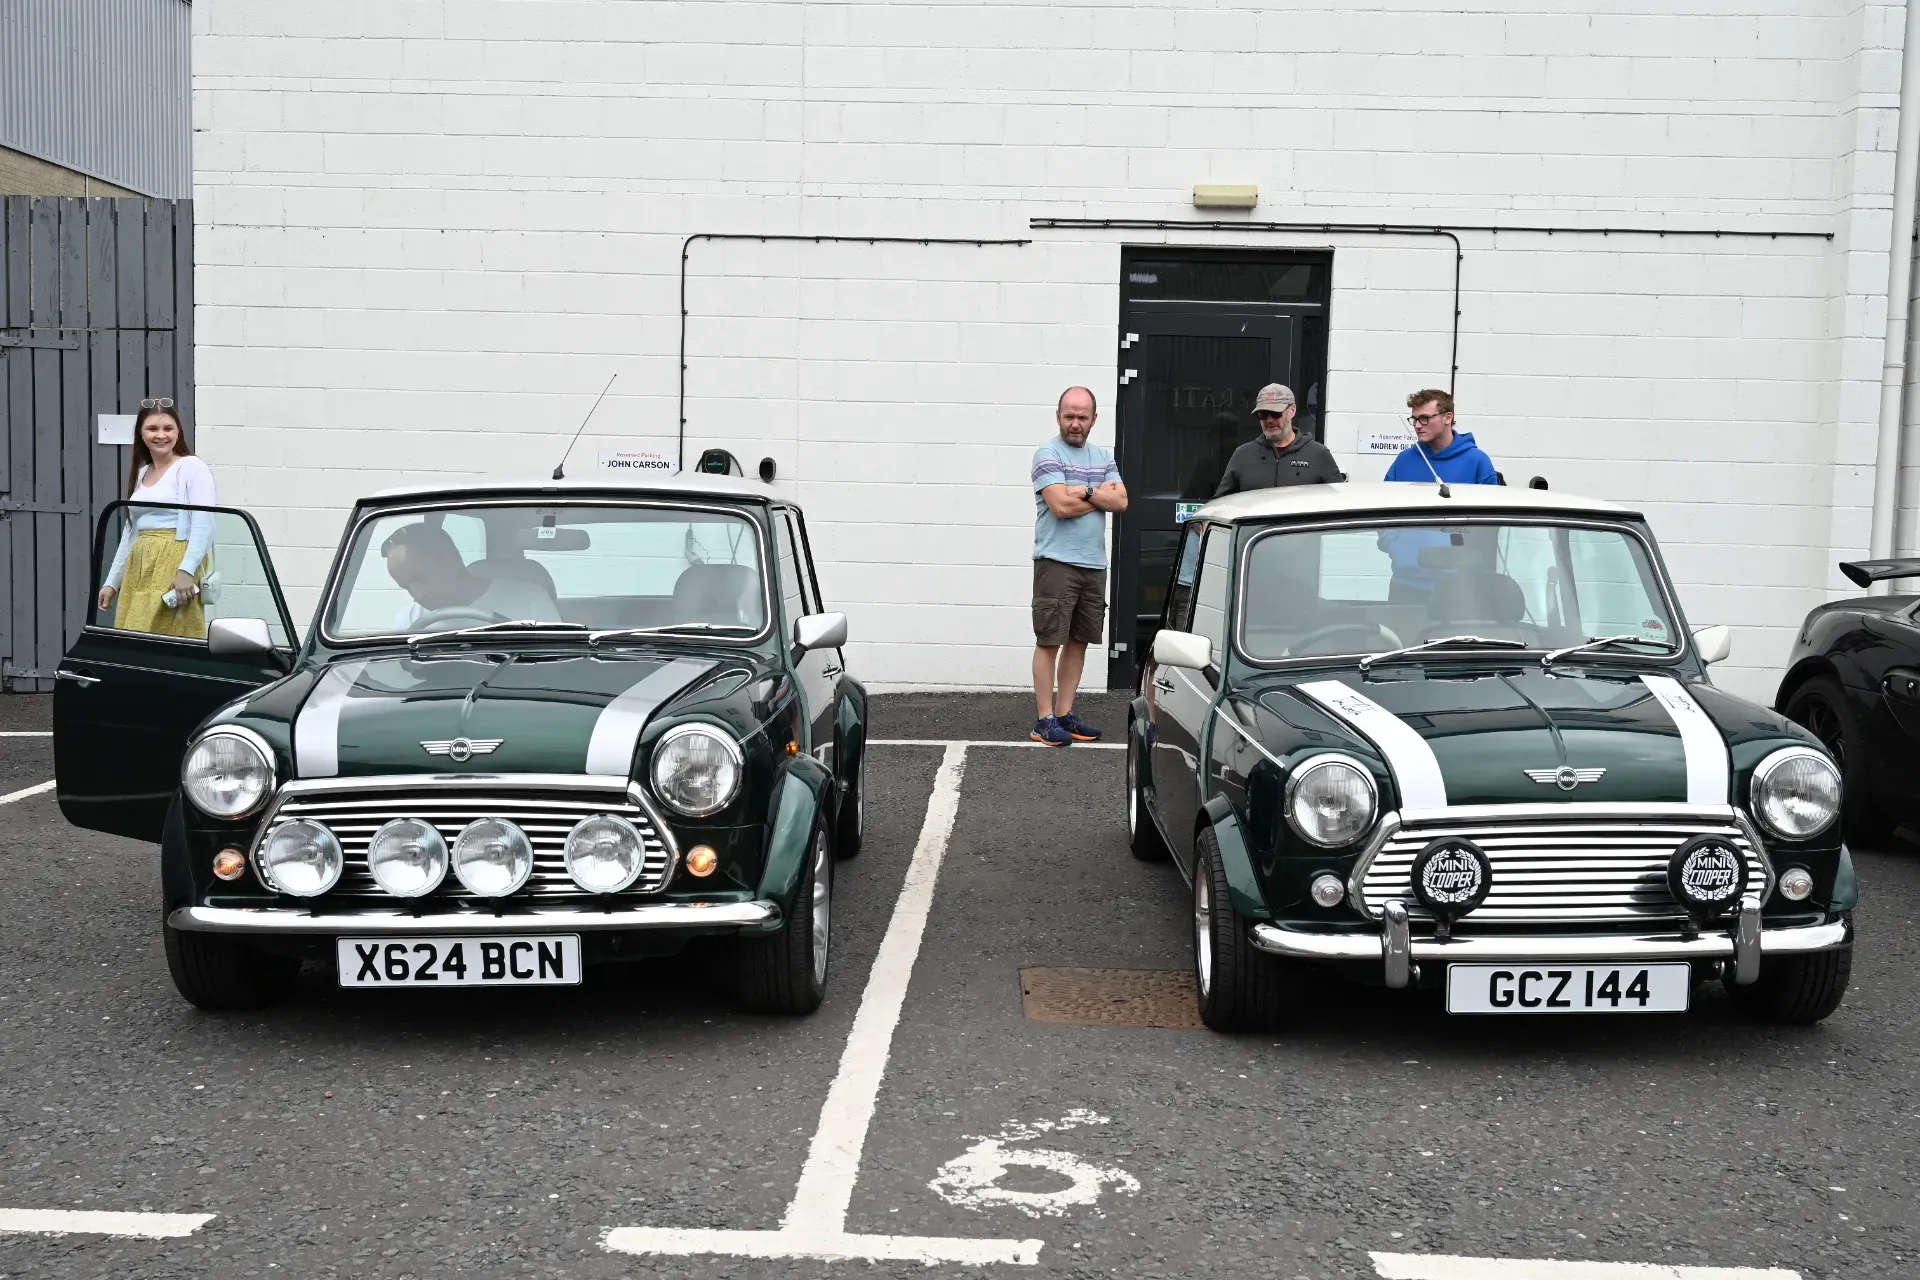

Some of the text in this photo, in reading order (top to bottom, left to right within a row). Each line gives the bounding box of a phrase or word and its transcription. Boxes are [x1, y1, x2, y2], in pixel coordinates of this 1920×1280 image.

[1370, 442, 1399, 450] ANDREW
[607, 460, 670, 469] JOHN CARSON
[1437, 858, 1469, 871] MINI
[1696, 856, 1727, 869] MINI
[1430, 870, 1475, 889] COOPER
[1688, 868, 1732, 887] COOPER
[355, 941, 564, 981] X624 BCN
[1489, 969, 1650, 1008] GCZ 144
